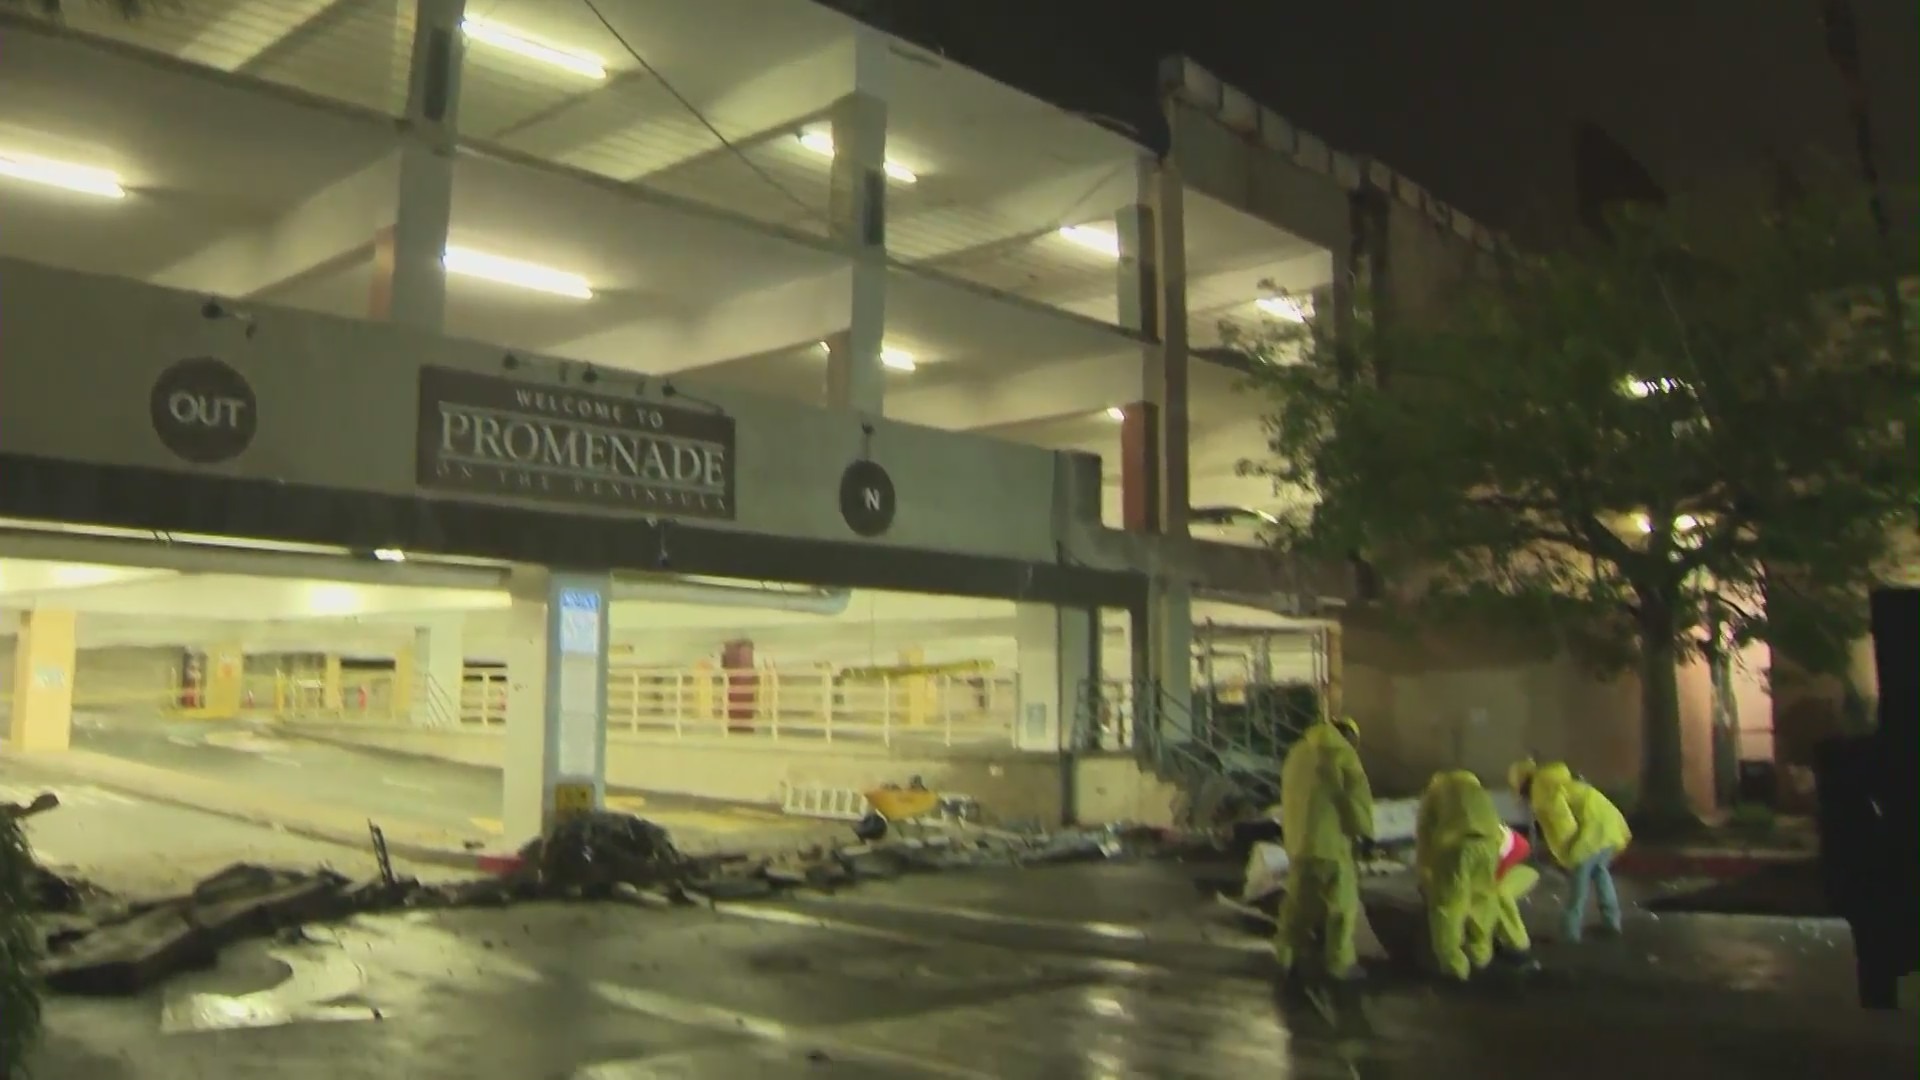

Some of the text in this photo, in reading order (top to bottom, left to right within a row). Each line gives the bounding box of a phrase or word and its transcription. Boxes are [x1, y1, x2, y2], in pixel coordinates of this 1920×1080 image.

[168, 392, 247, 428] OUT
[515, 388, 664, 429] WELCOME TO
[440, 410, 726, 486] PROMENADE
